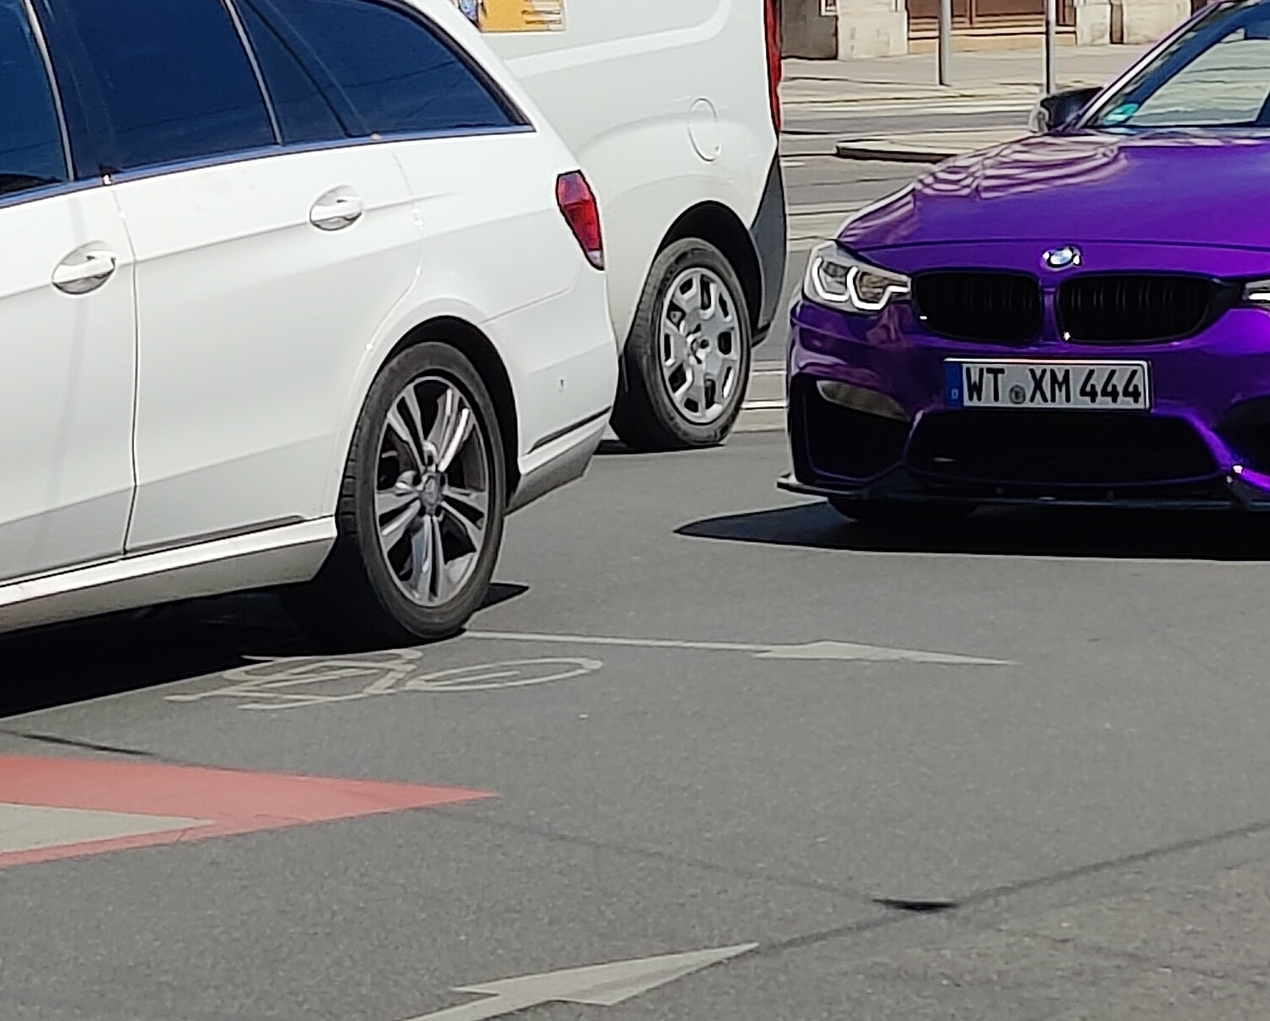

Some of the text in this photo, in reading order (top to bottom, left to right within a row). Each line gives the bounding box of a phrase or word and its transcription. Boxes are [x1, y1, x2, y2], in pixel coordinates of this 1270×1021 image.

[965, 366, 1142, 403] WT XM 444
